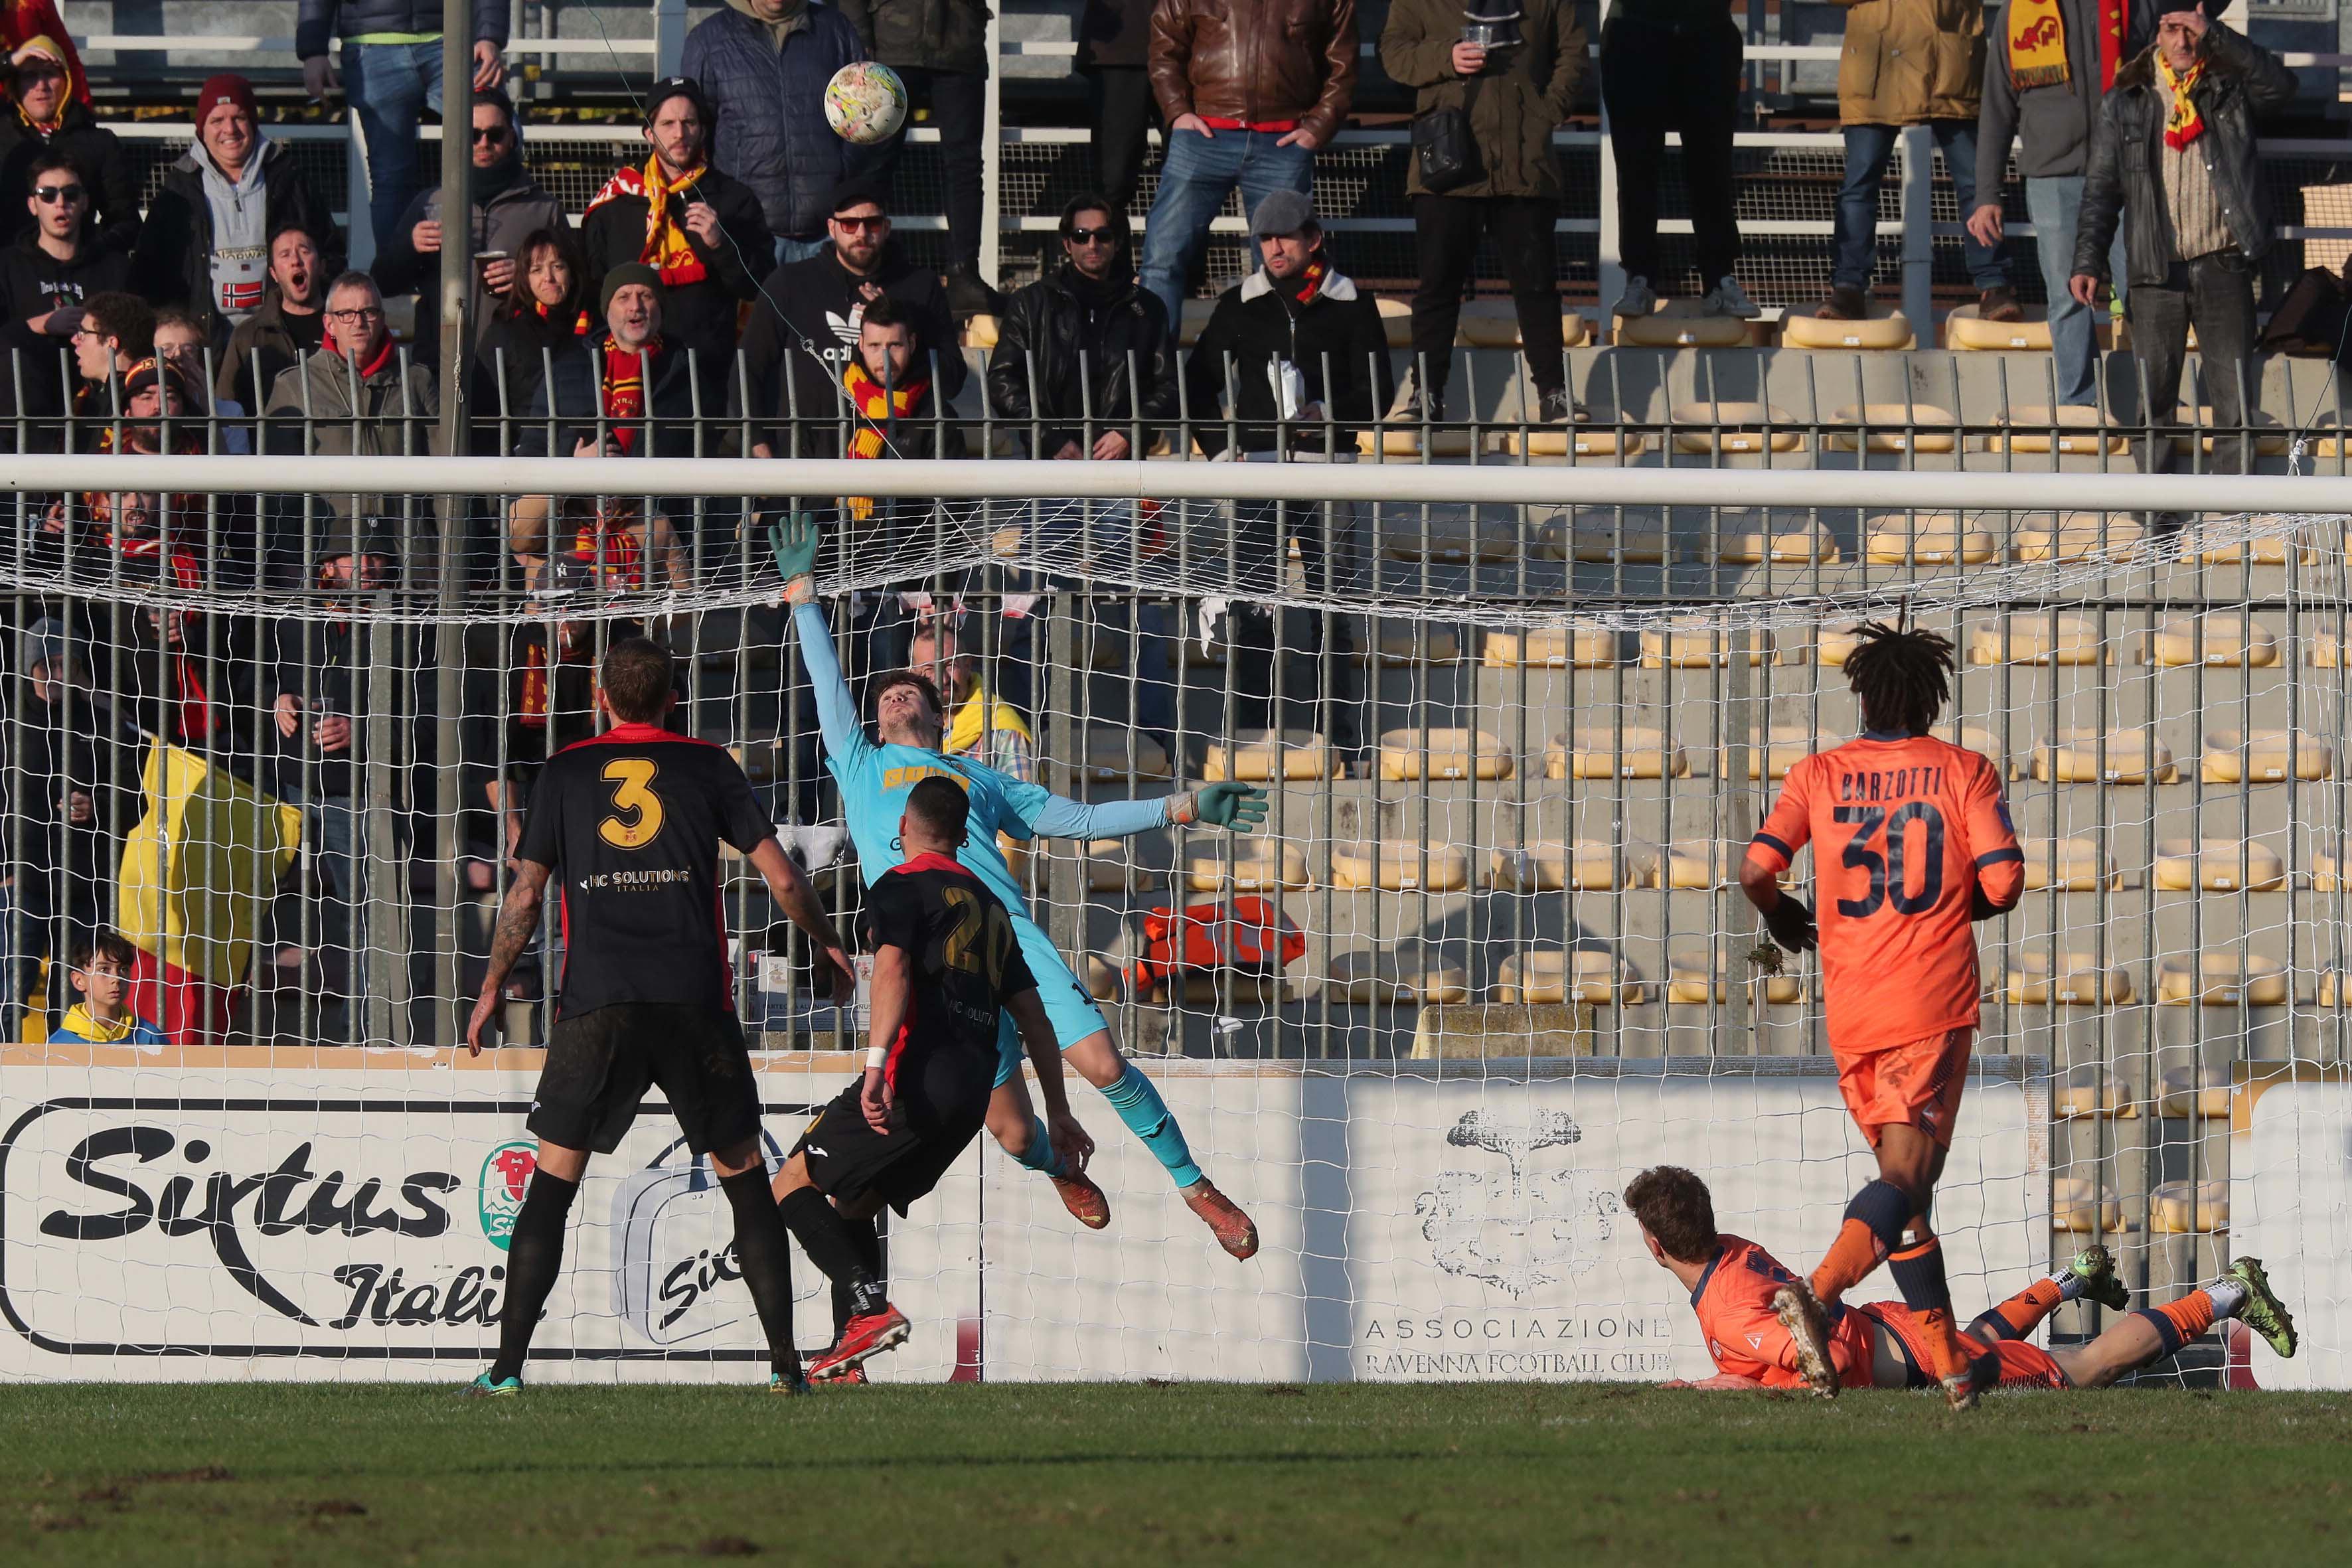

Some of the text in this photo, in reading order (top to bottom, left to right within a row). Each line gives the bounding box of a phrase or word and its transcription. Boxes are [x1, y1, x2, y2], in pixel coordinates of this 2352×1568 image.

[823, 345, 852, 362] adi
[1842, 766, 1942, 801] BARZOTTI
[597, 757, 665, 851] 3
[1832, 801, 1944, 919] 30
[612, 869, 690, 885] SOLUTIONS
[617, 884, 659, 893] ITALIA
[941, 884, 1013, 993] 20
[329, 1263, 548, 1330] Itali
[1366, 1318, 1671, 1340] ASSOCIAZIONE
[1366, 1353, 1672, 1375] RAVENNA FOOTBALL CLUB
